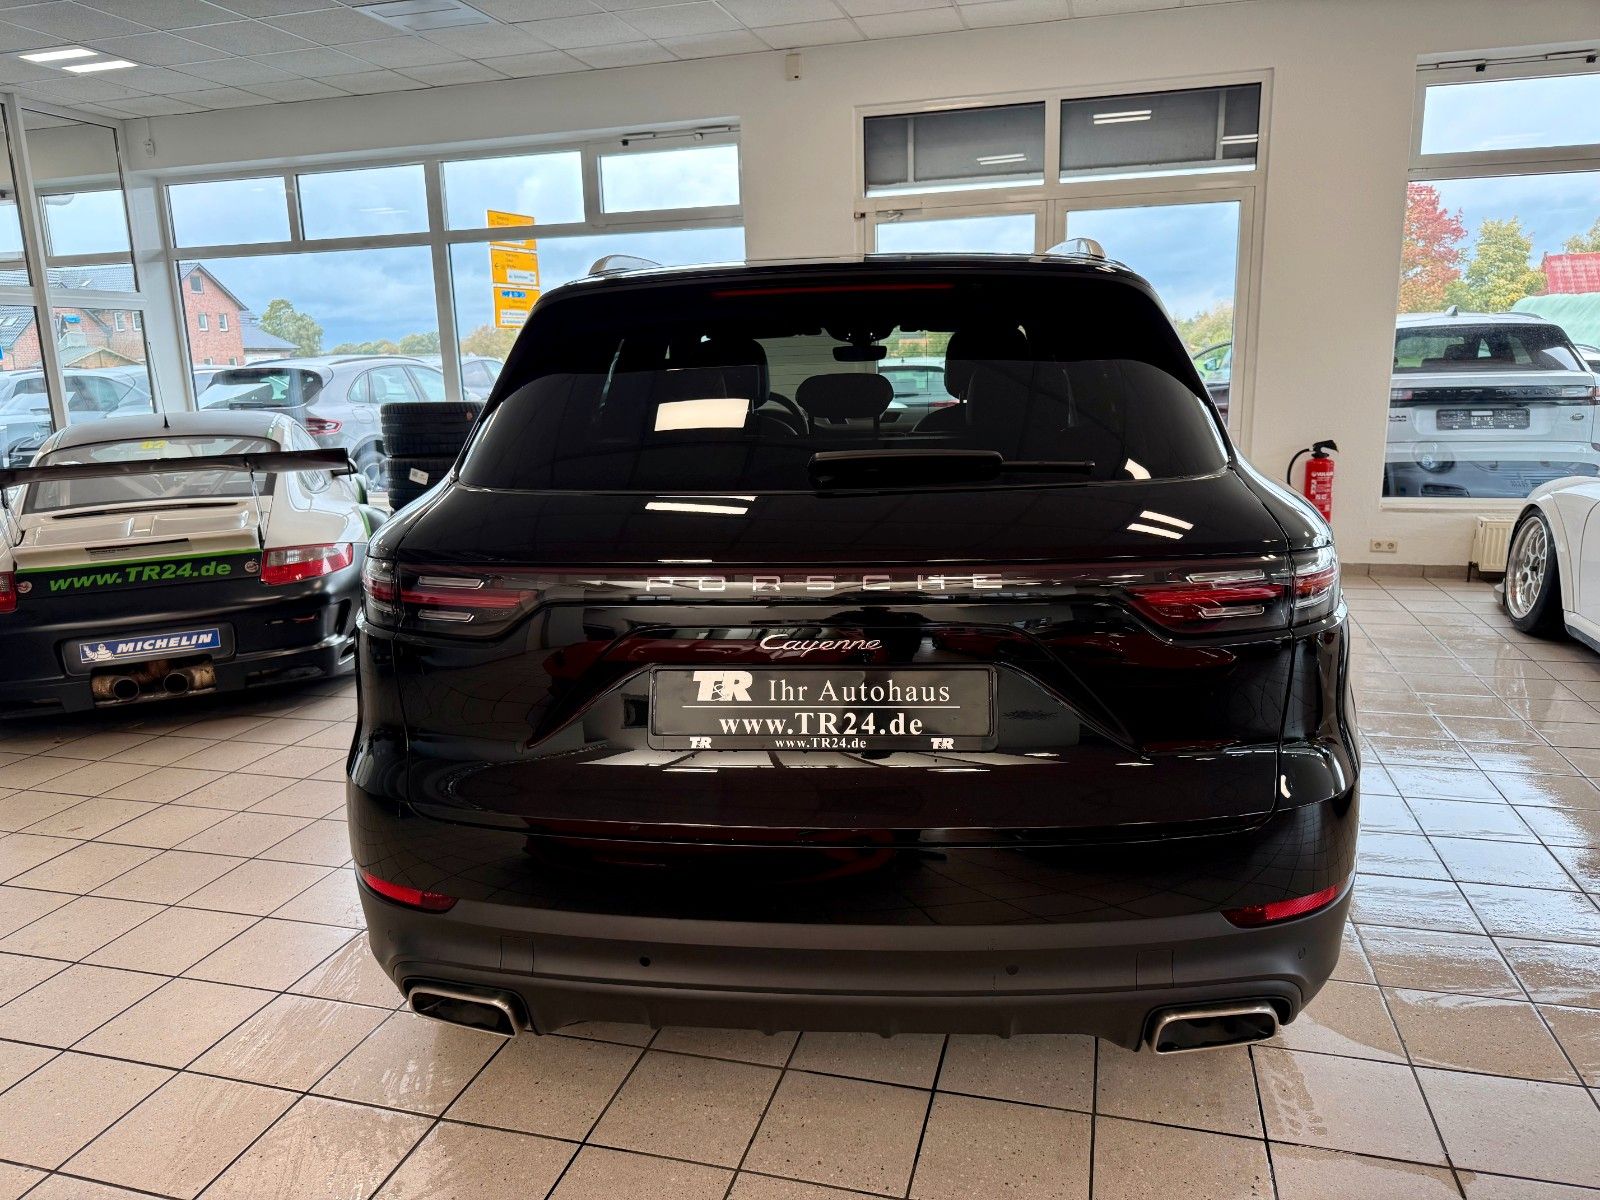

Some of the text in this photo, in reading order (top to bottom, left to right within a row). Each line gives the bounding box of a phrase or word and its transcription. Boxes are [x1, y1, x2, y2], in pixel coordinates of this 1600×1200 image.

[50, 561, 232, 592] www.TR24.de
[646, 573, 1003, 592] PORSCHE
[116, 633, 213, 654] MICHELIN
[759, 633, 883, 658] Cayenne
[768, 679, 808, 701] Ihr
[818, 679, 951, 702] Autohaus
[719, 712, 923, 735] www.TR24.de
[775, 737, 867, 749] www.TR24.de
